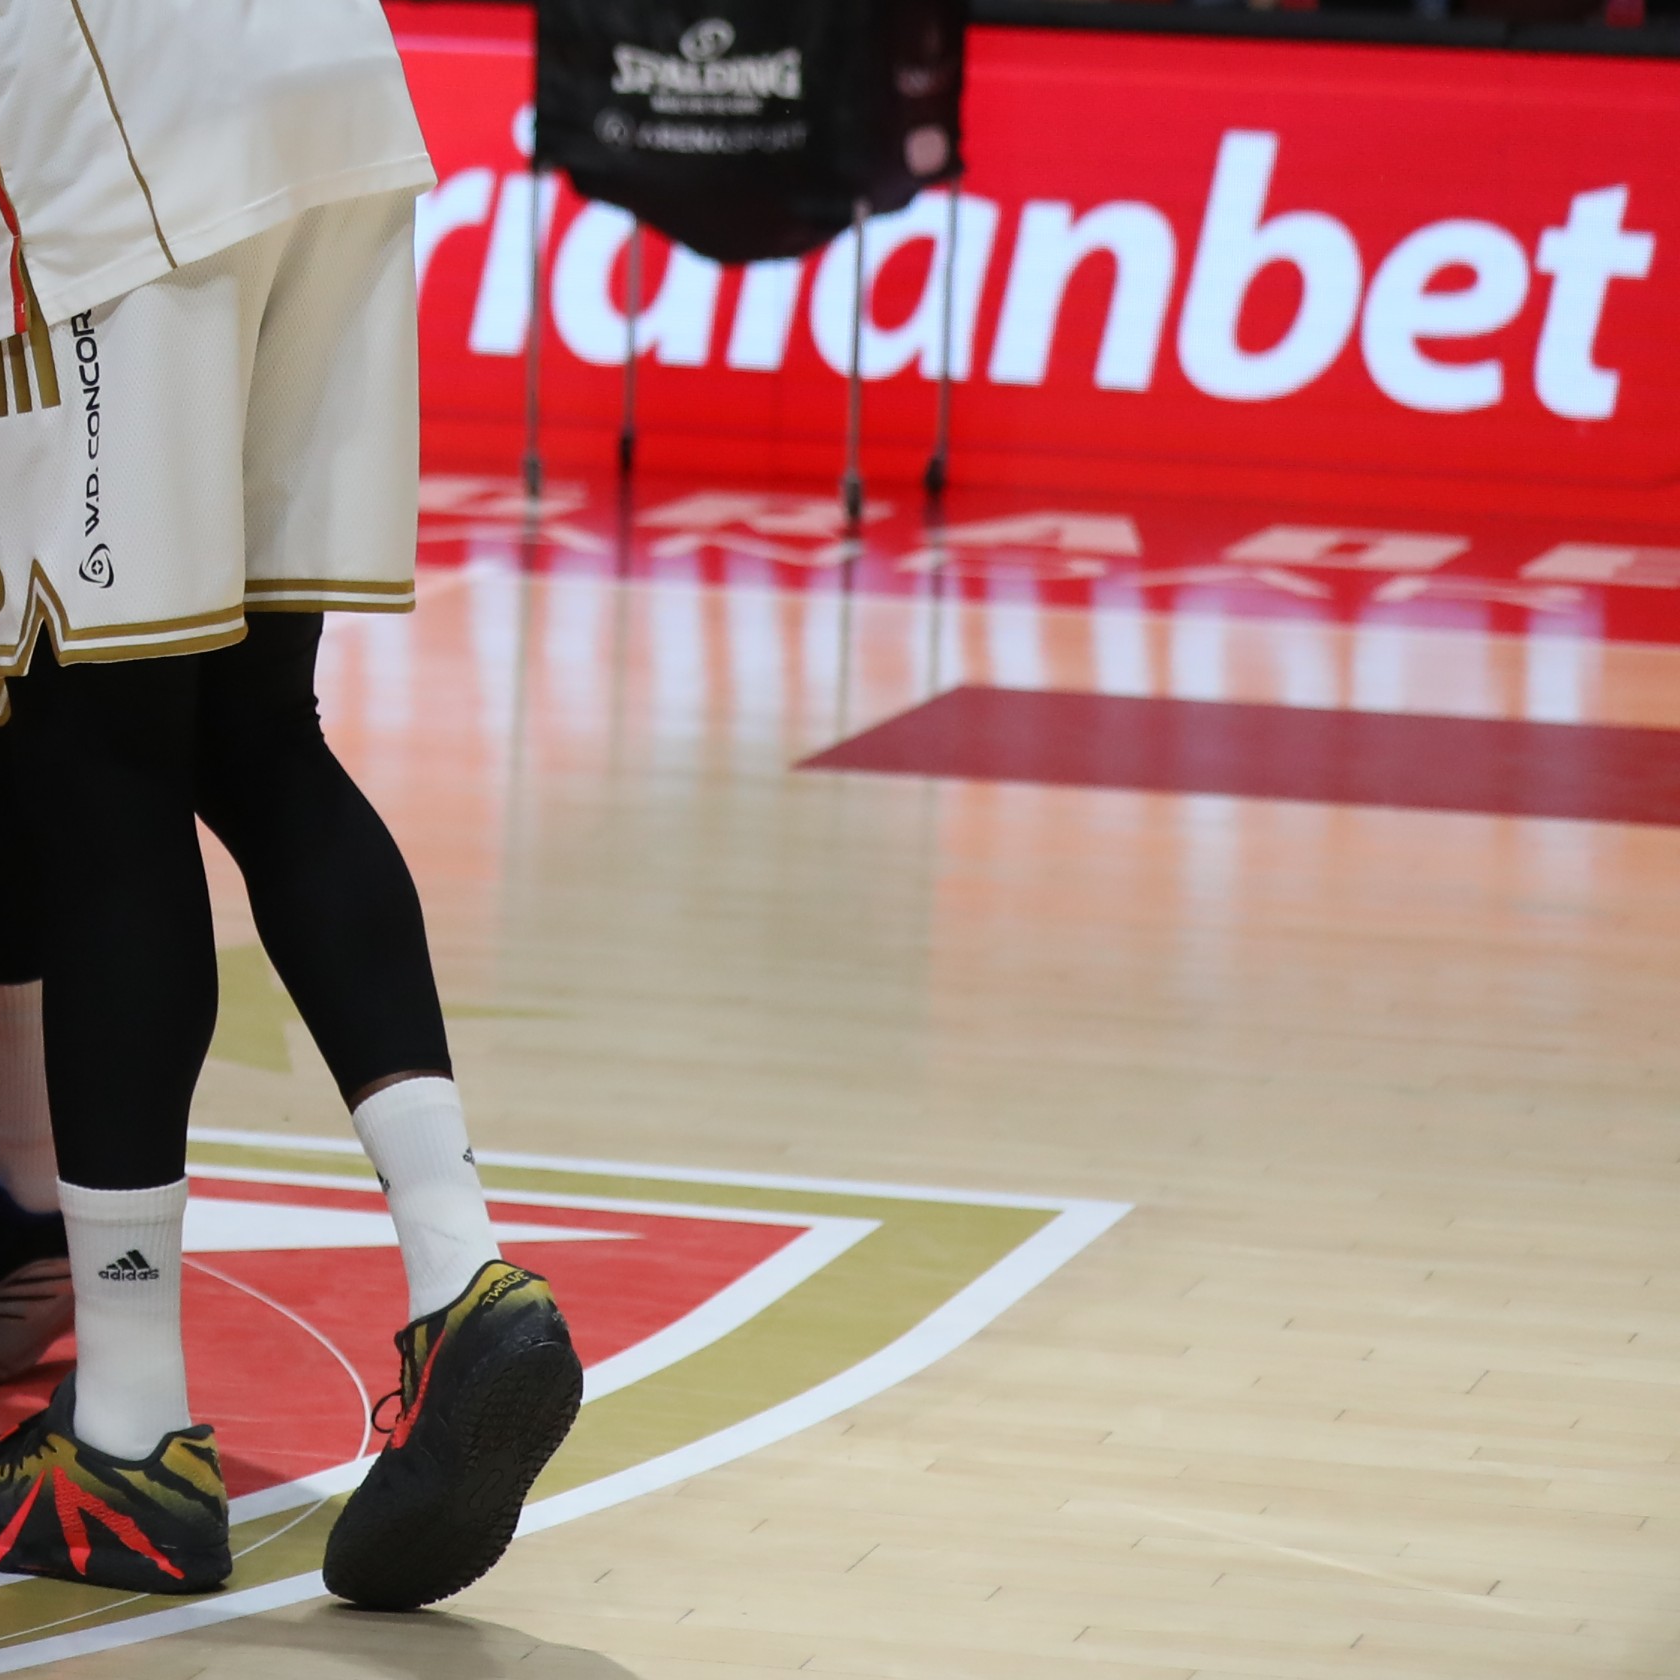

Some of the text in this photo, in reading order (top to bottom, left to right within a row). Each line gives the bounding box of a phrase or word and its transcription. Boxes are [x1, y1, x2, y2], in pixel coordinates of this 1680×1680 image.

[71, 308, 100, 538] W.D. CONCOR
[98, 1268, 159, 1281] adidas
